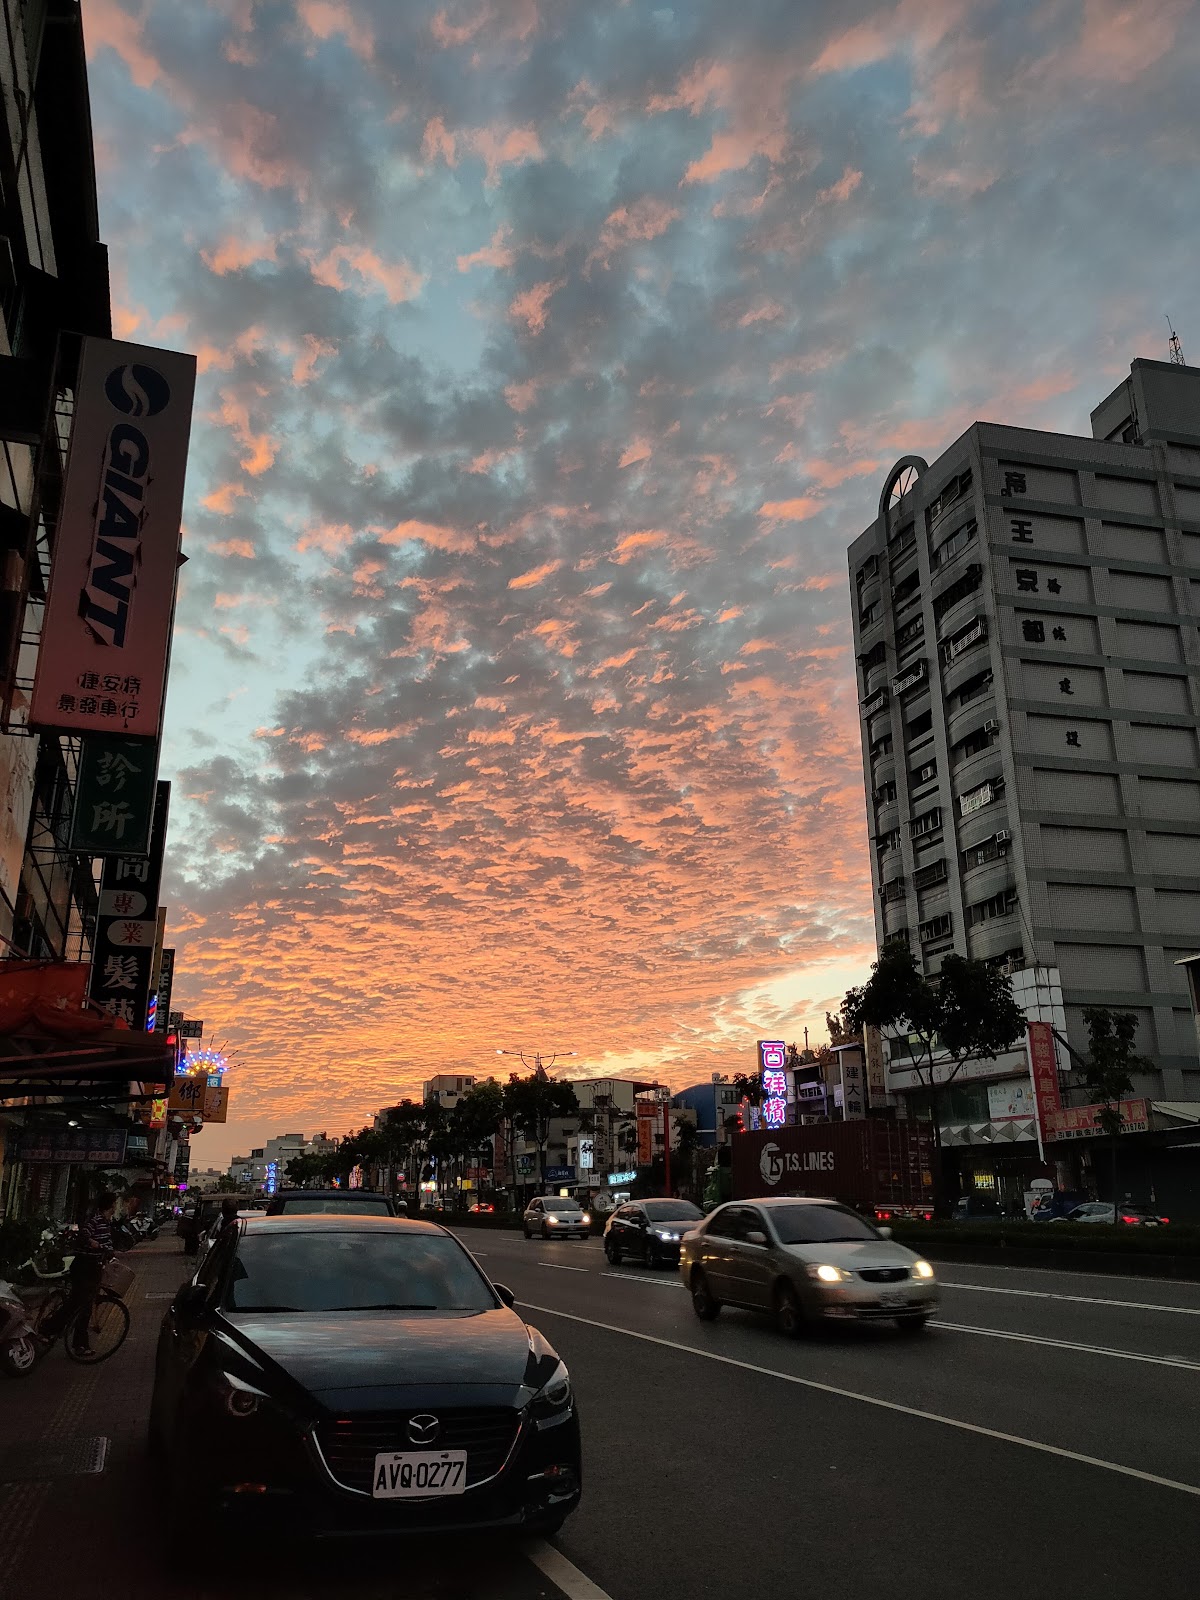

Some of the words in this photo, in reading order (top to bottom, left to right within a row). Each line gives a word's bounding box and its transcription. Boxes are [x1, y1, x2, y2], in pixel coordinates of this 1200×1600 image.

[84, 423, 150, 648] GIANT
[57, 693, 139, 718] 景發車行
[80, 671, 142, 695] 捷安特
[91, 742, 142, 839] 診所
[760, 1041, 787, 1130] 百祥檳
[845, 1066, 861, 1120] 建大輪
[803, 1151, 834, 1171] LINES
